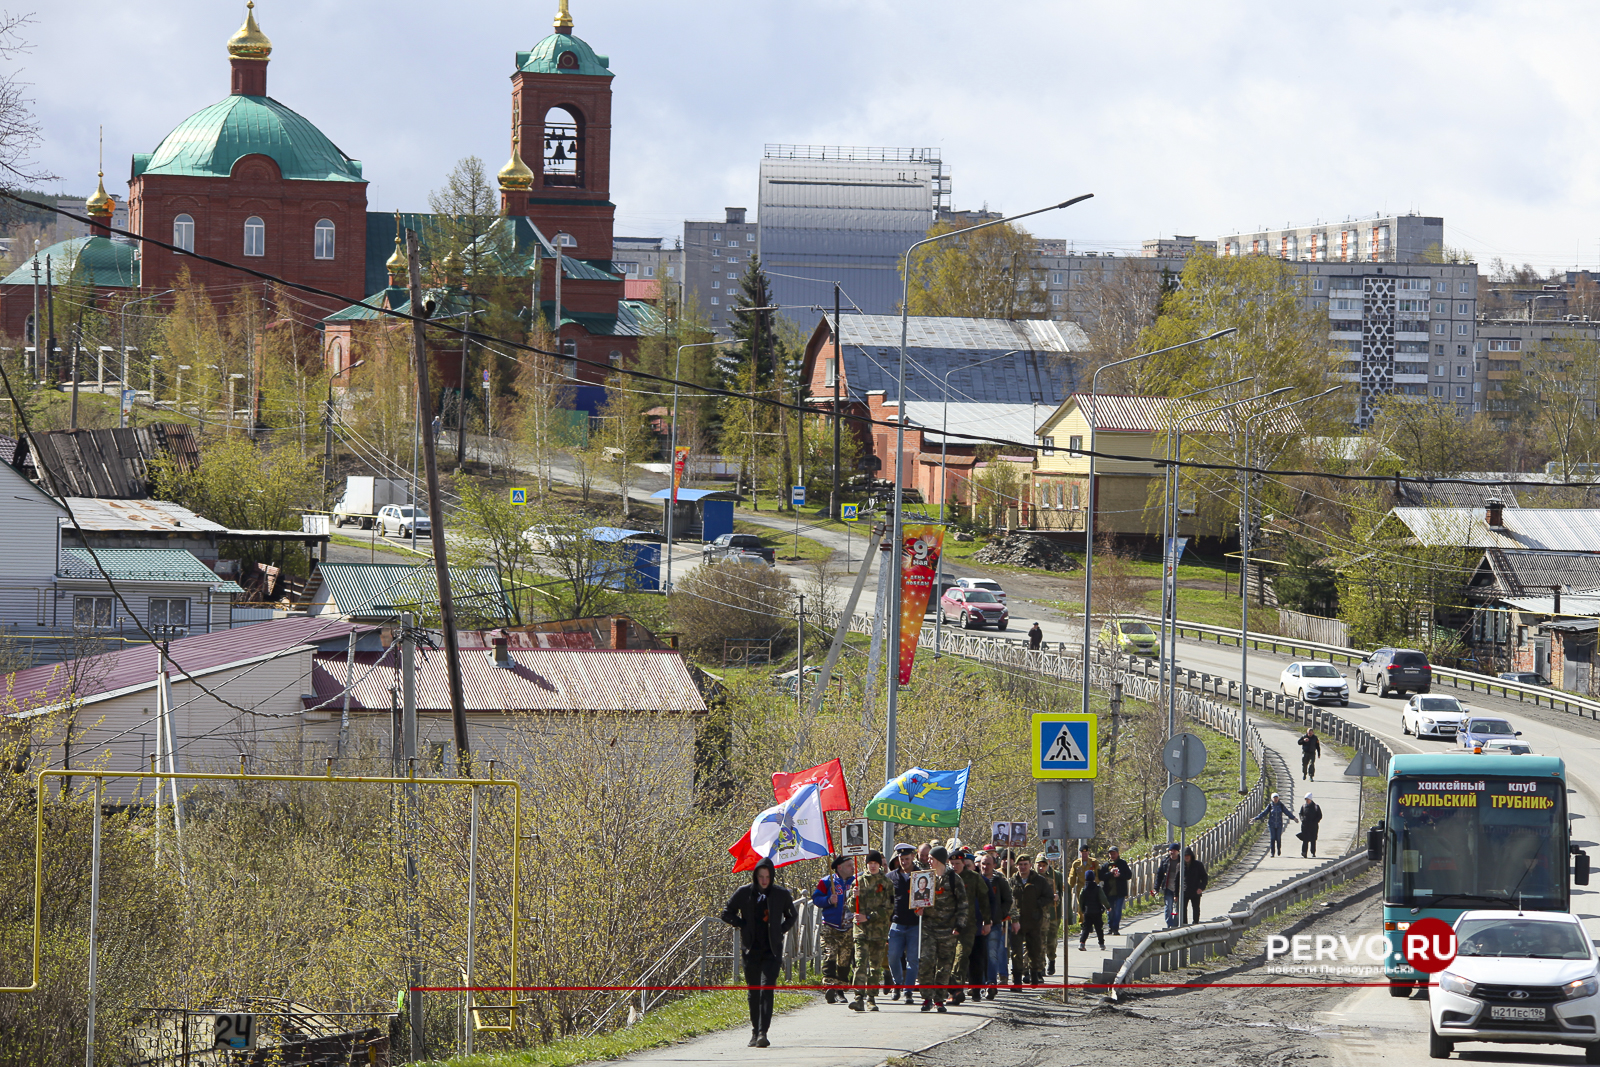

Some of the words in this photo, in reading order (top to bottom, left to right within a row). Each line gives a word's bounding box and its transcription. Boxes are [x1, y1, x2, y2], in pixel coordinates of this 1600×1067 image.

[914, 540, 928, 559] 9
[1417, 781, 1486, 791] хоккейный
[1508, 781, 1537, 793] клуб
[1398, 792, 1477, 807] «УРАЛЬСКИЙ
[1491, 795, 1554, 809] ТРУБНИК»
[215, 1014, 252, 1047] 24
